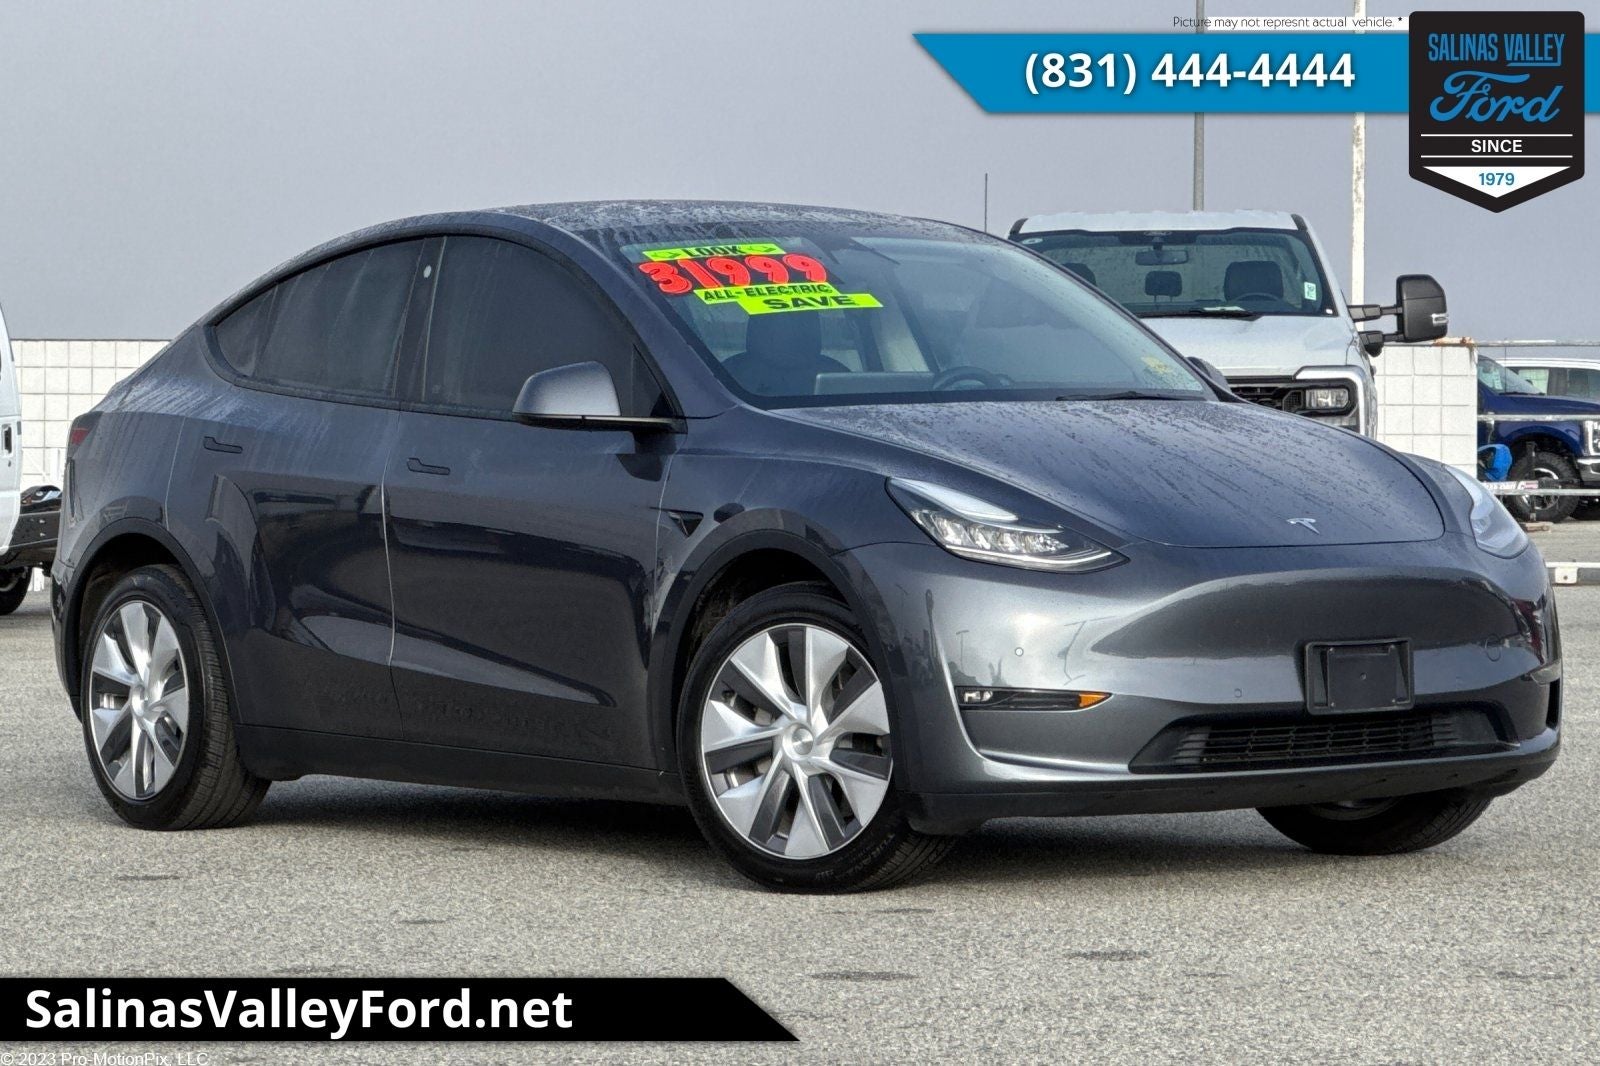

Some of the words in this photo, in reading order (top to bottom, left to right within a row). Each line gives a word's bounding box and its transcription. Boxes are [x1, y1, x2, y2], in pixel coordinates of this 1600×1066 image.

[681, 245, 743, 257] LOOK
[638, 253, 827, 295] 31999
[703, 283, 833, 301] ALL-ELECTRIC
[762, 295, 856, 310] SAVE
